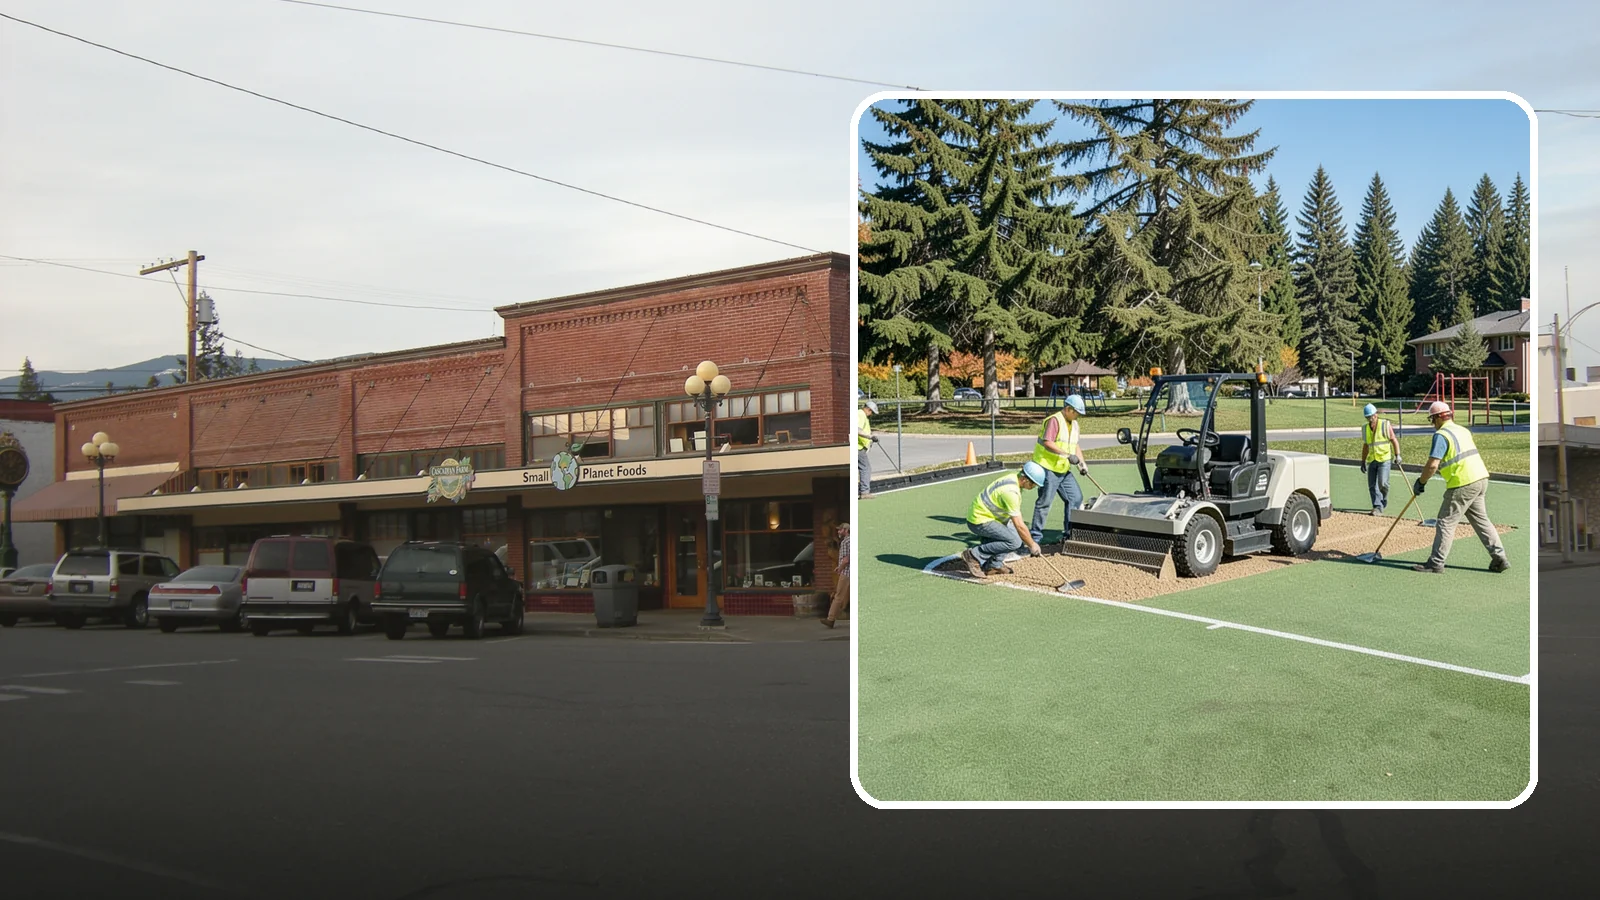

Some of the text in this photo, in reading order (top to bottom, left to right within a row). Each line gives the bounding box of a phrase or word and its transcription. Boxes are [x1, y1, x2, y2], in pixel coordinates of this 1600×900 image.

[523, 464, 647, 482] Small Planet Foods
